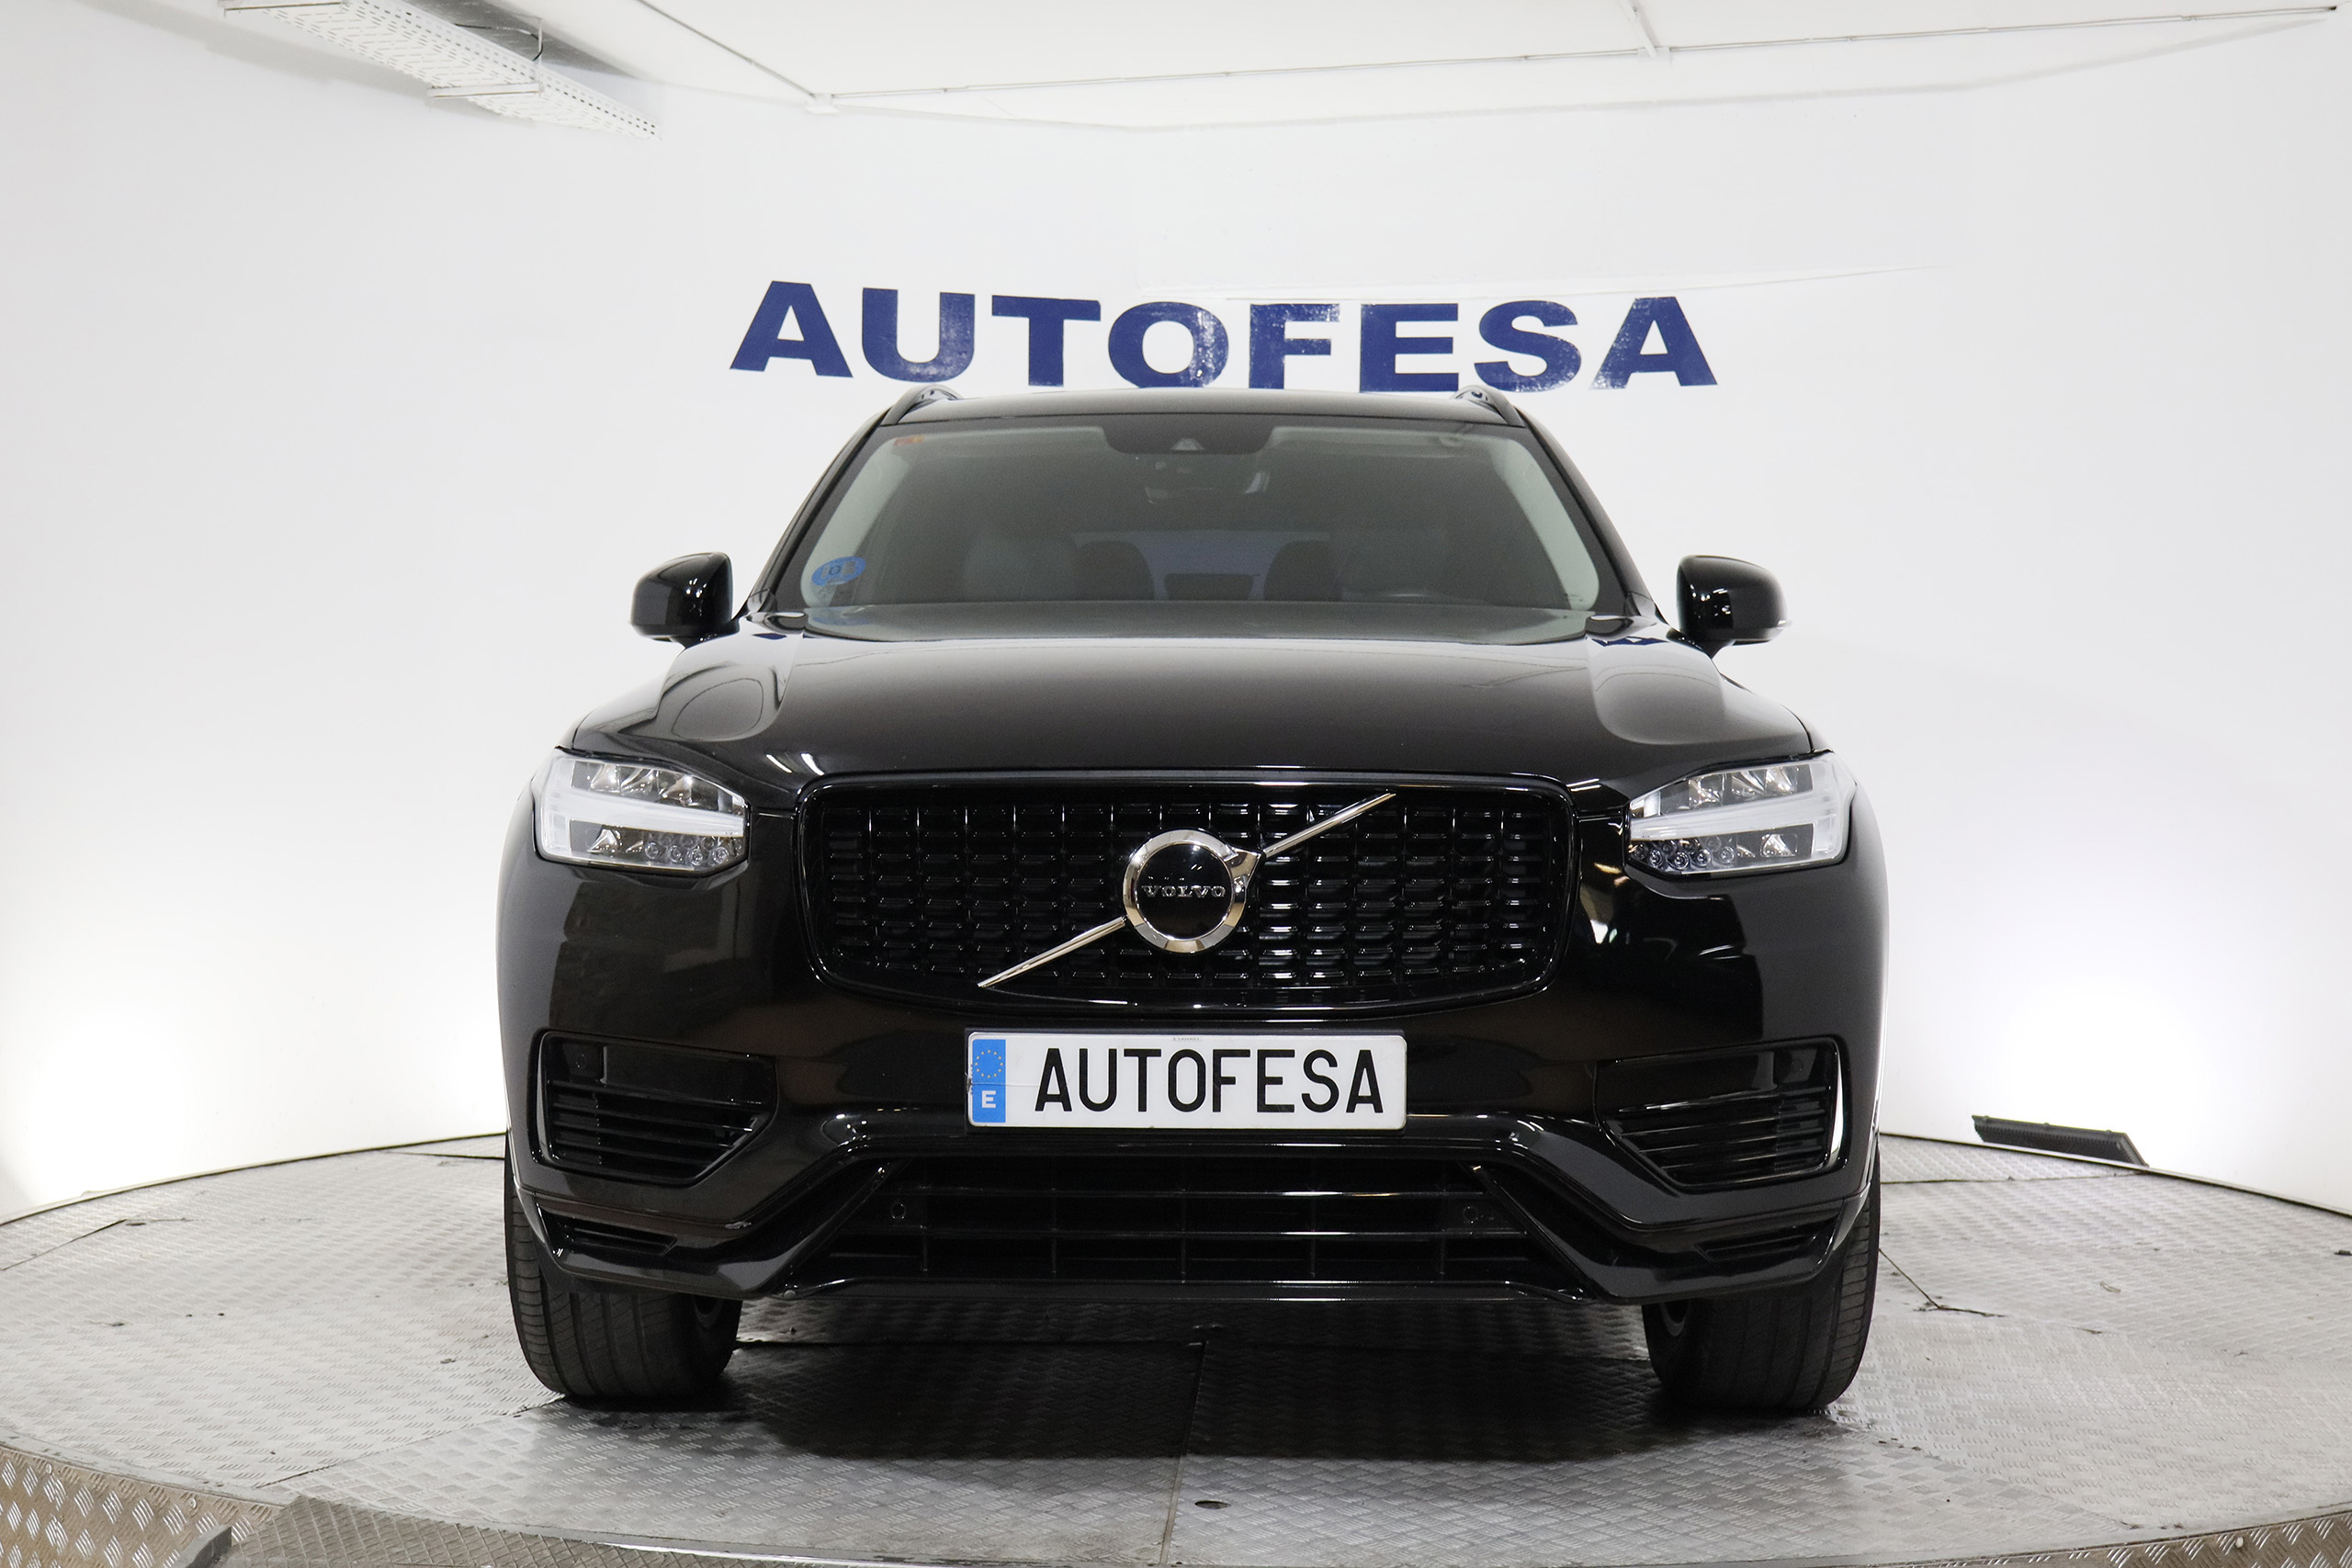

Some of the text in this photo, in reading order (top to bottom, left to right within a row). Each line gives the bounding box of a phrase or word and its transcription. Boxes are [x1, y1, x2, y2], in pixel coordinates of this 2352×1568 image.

[730, 281, 1716, 392] AUTOFESA
[1141, 885, 1227, 898] VOLVO
[981, 1047, 1385, 1113] E AUTOFESA
